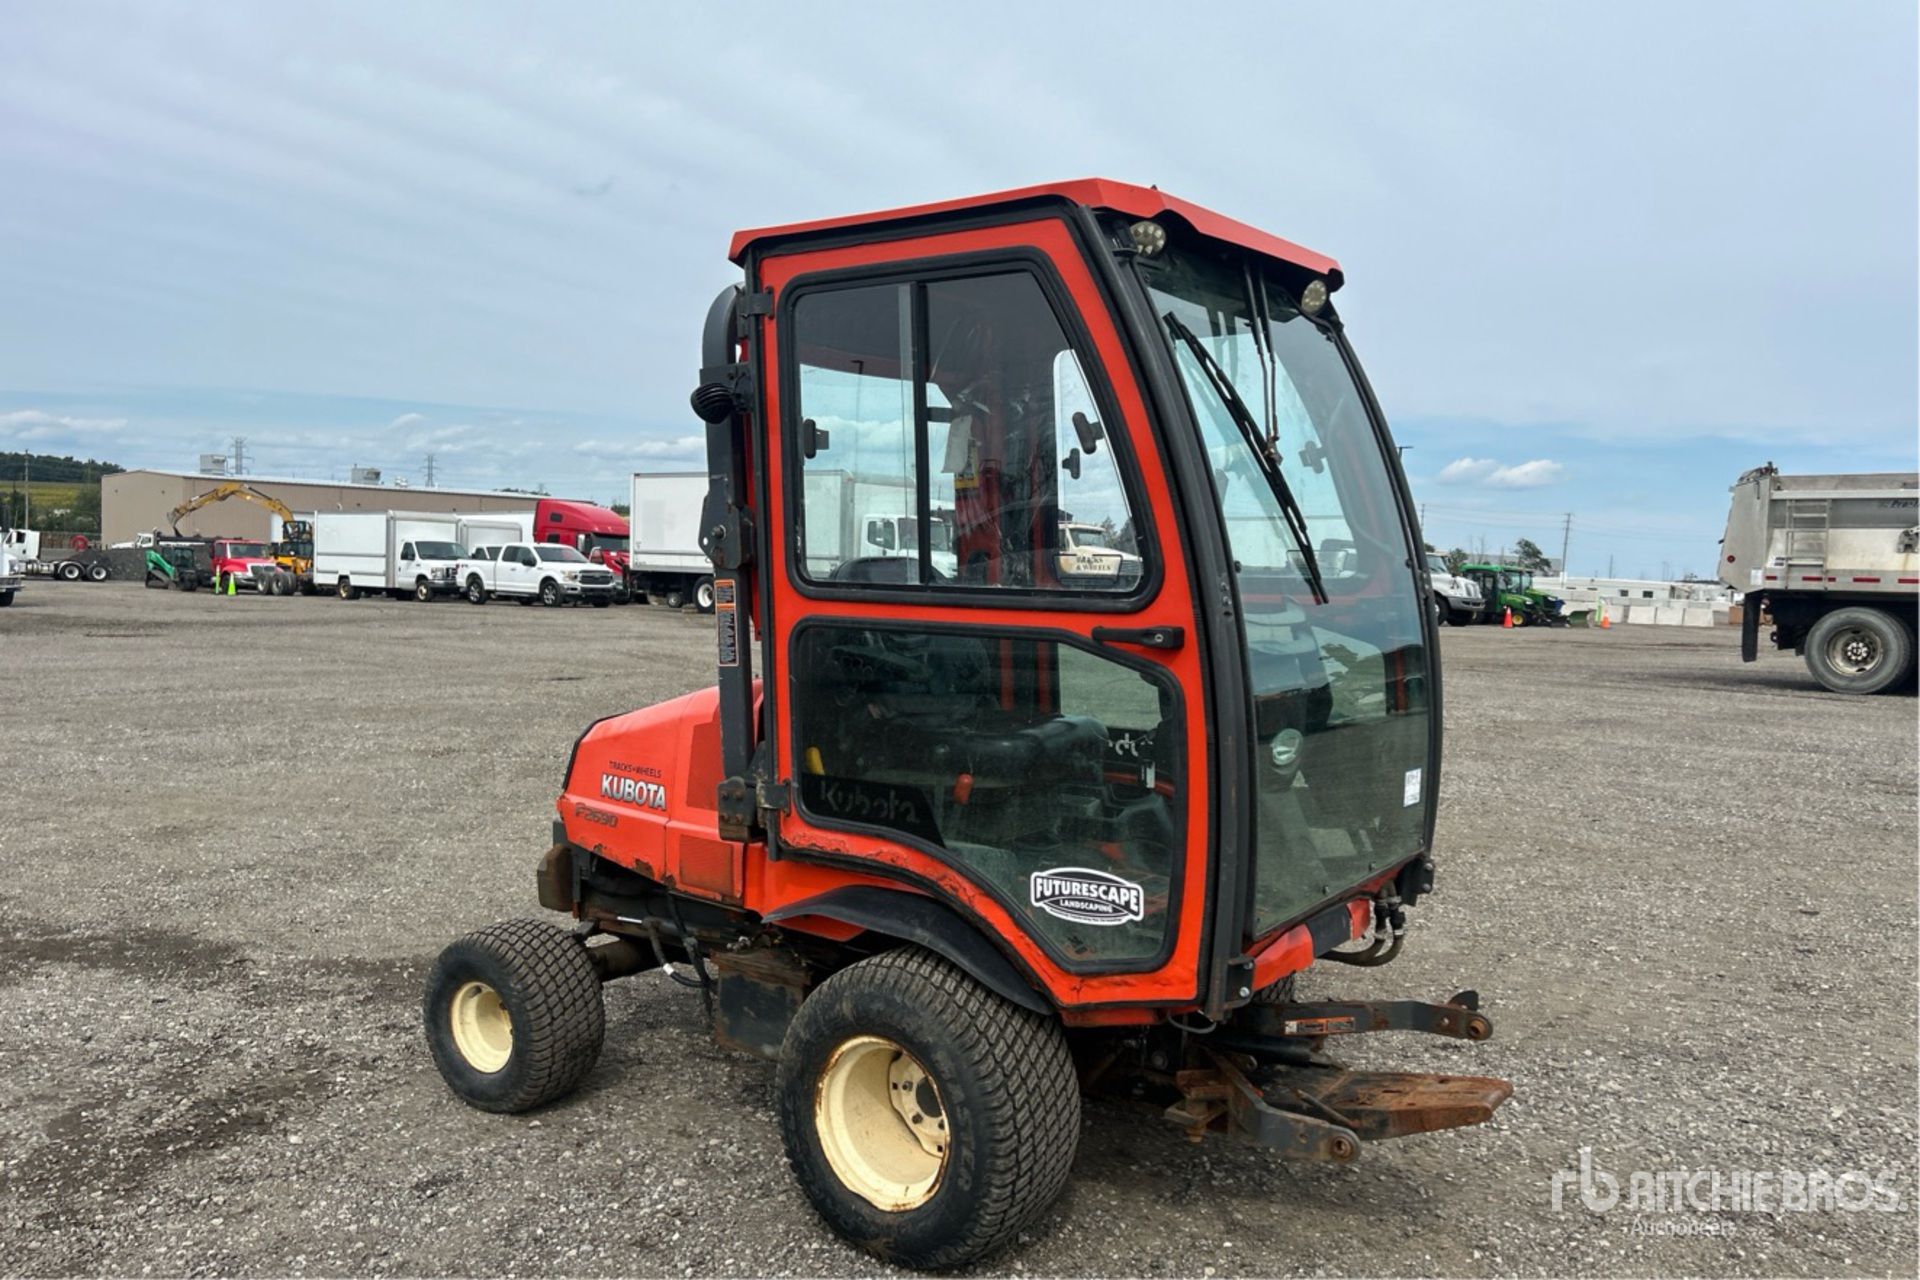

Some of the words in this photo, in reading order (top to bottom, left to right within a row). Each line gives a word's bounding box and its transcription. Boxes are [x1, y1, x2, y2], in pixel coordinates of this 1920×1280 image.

[601, 773, 667, 811] KUBOTA
[820, 779, 921, 824] Kubota
[575, 801, 619, 828] F2690
[1035, 877, 1139, 913] FUTURESCAPE
[1060, 899, 1113, 913] LANDSCAPING
